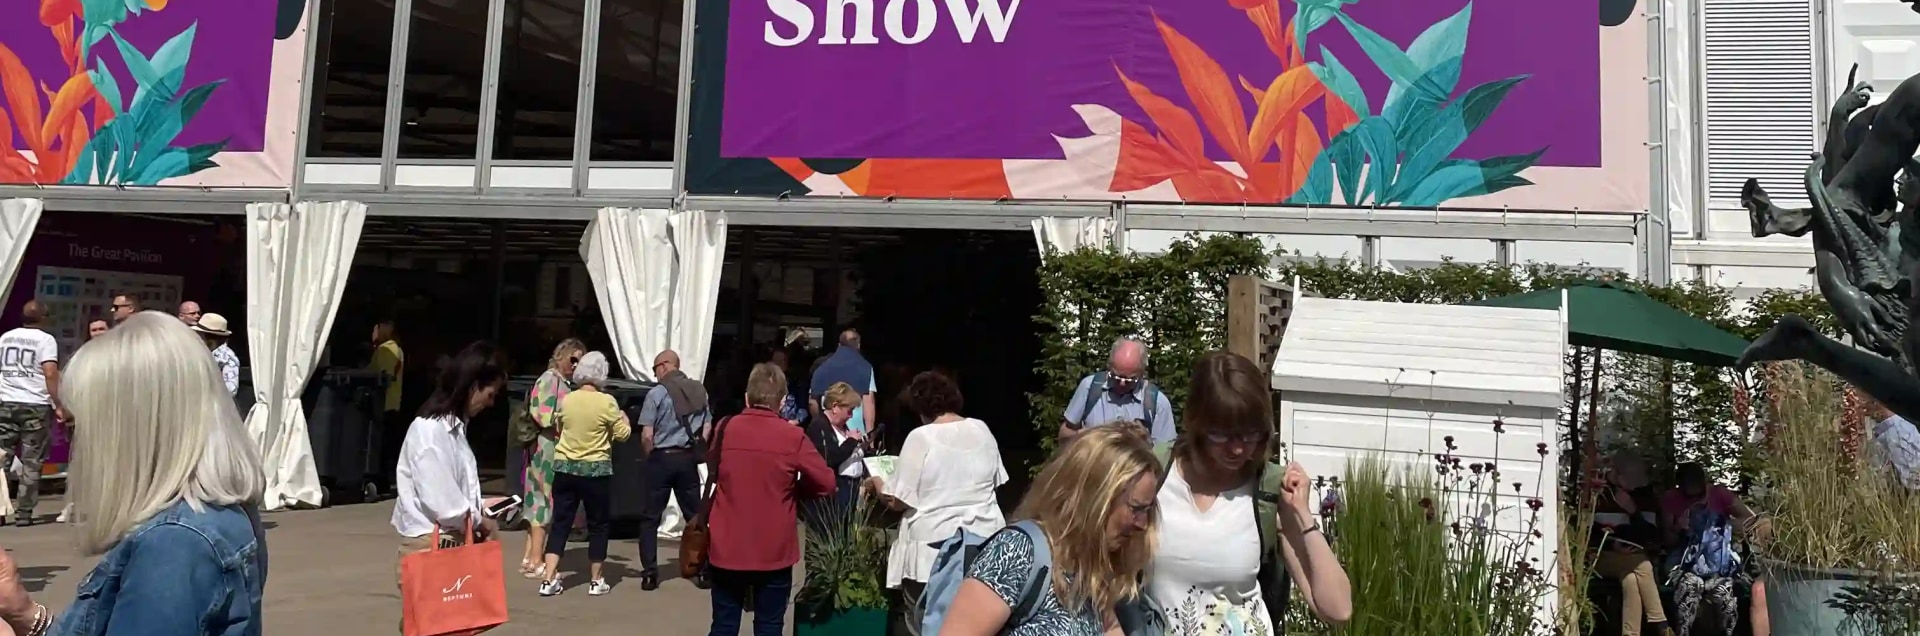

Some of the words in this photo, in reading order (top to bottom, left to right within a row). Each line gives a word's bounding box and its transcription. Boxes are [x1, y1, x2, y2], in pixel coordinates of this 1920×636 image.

[764, 0, 1020, 46] Show
[68, 243, 89, 258] The
[91, 245, 121, 260] Great
[124, 248, 163, 264] Pavilion
